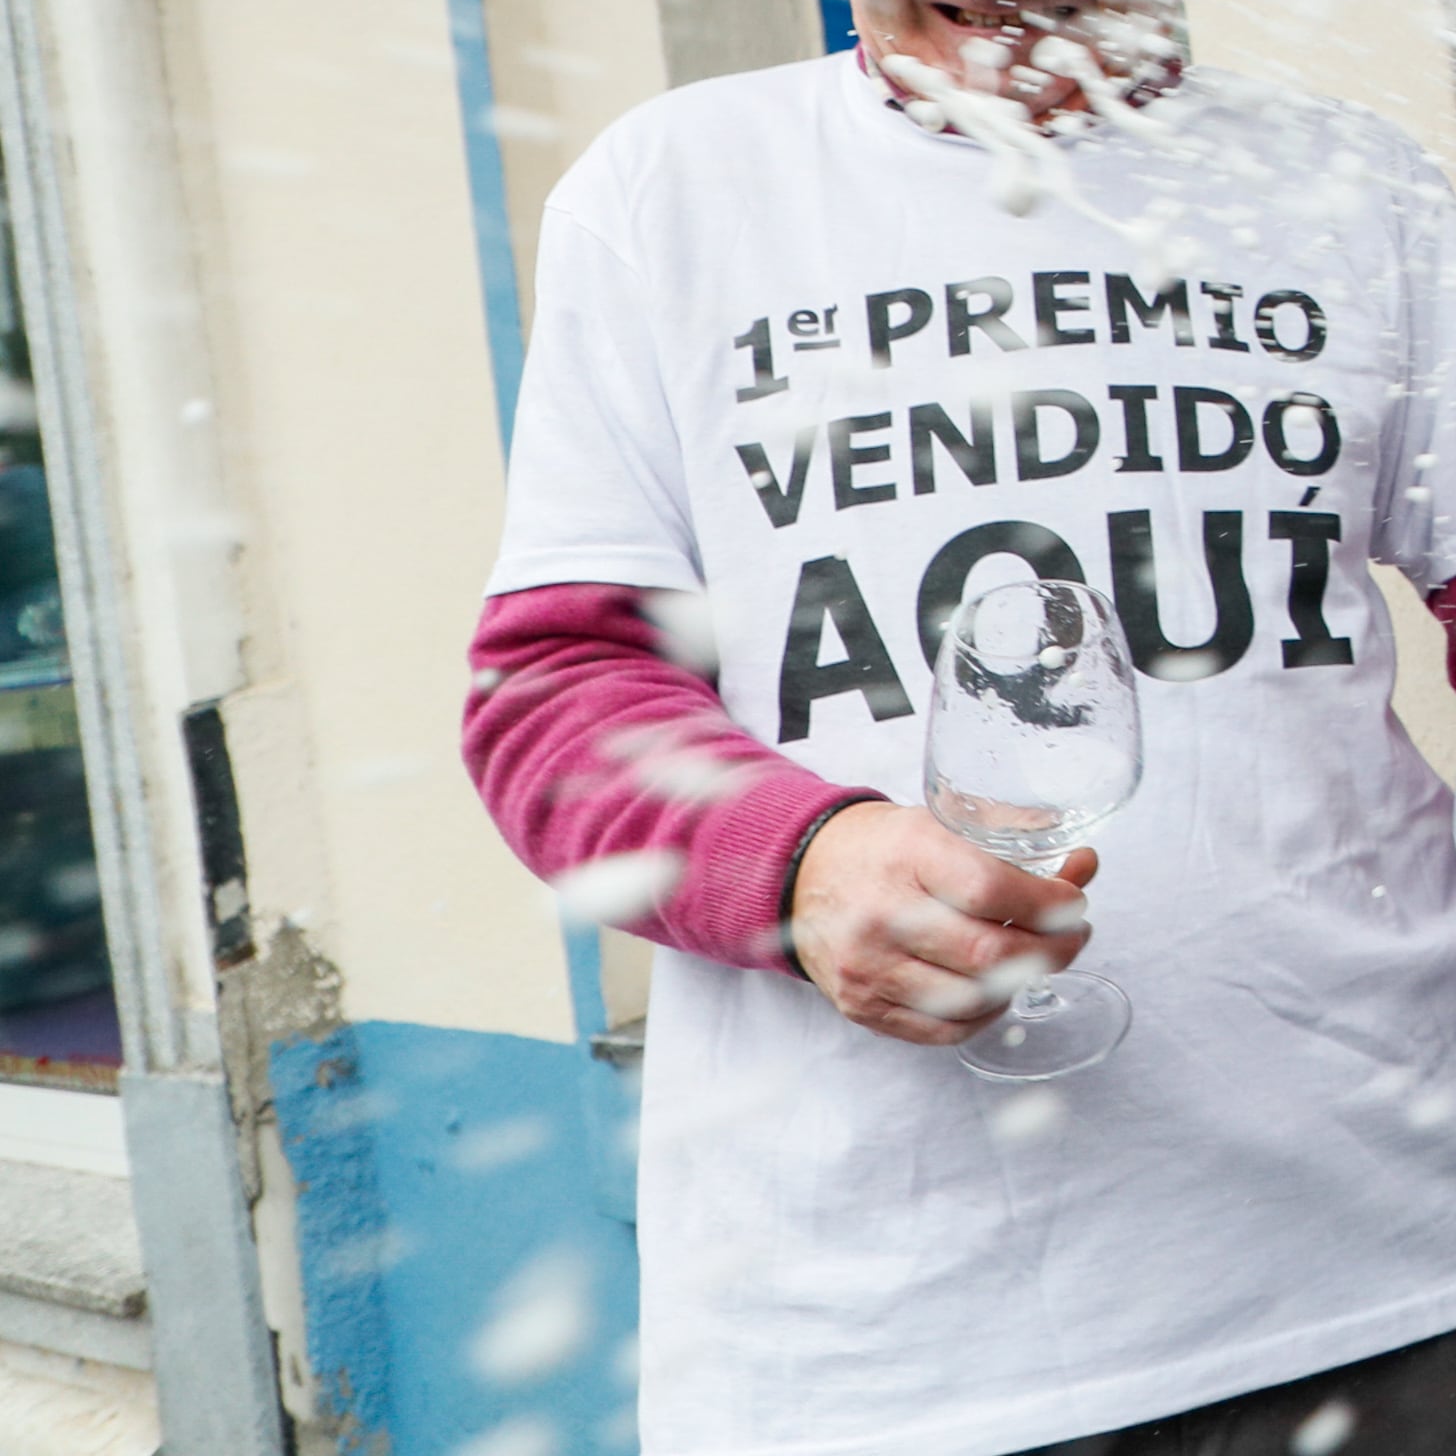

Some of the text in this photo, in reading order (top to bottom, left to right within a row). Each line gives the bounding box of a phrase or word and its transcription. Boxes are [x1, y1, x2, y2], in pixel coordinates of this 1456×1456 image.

[733, 270, 1328, 403] 1er PREMIO
[733, 384, 1342, 529] VENDIDO
